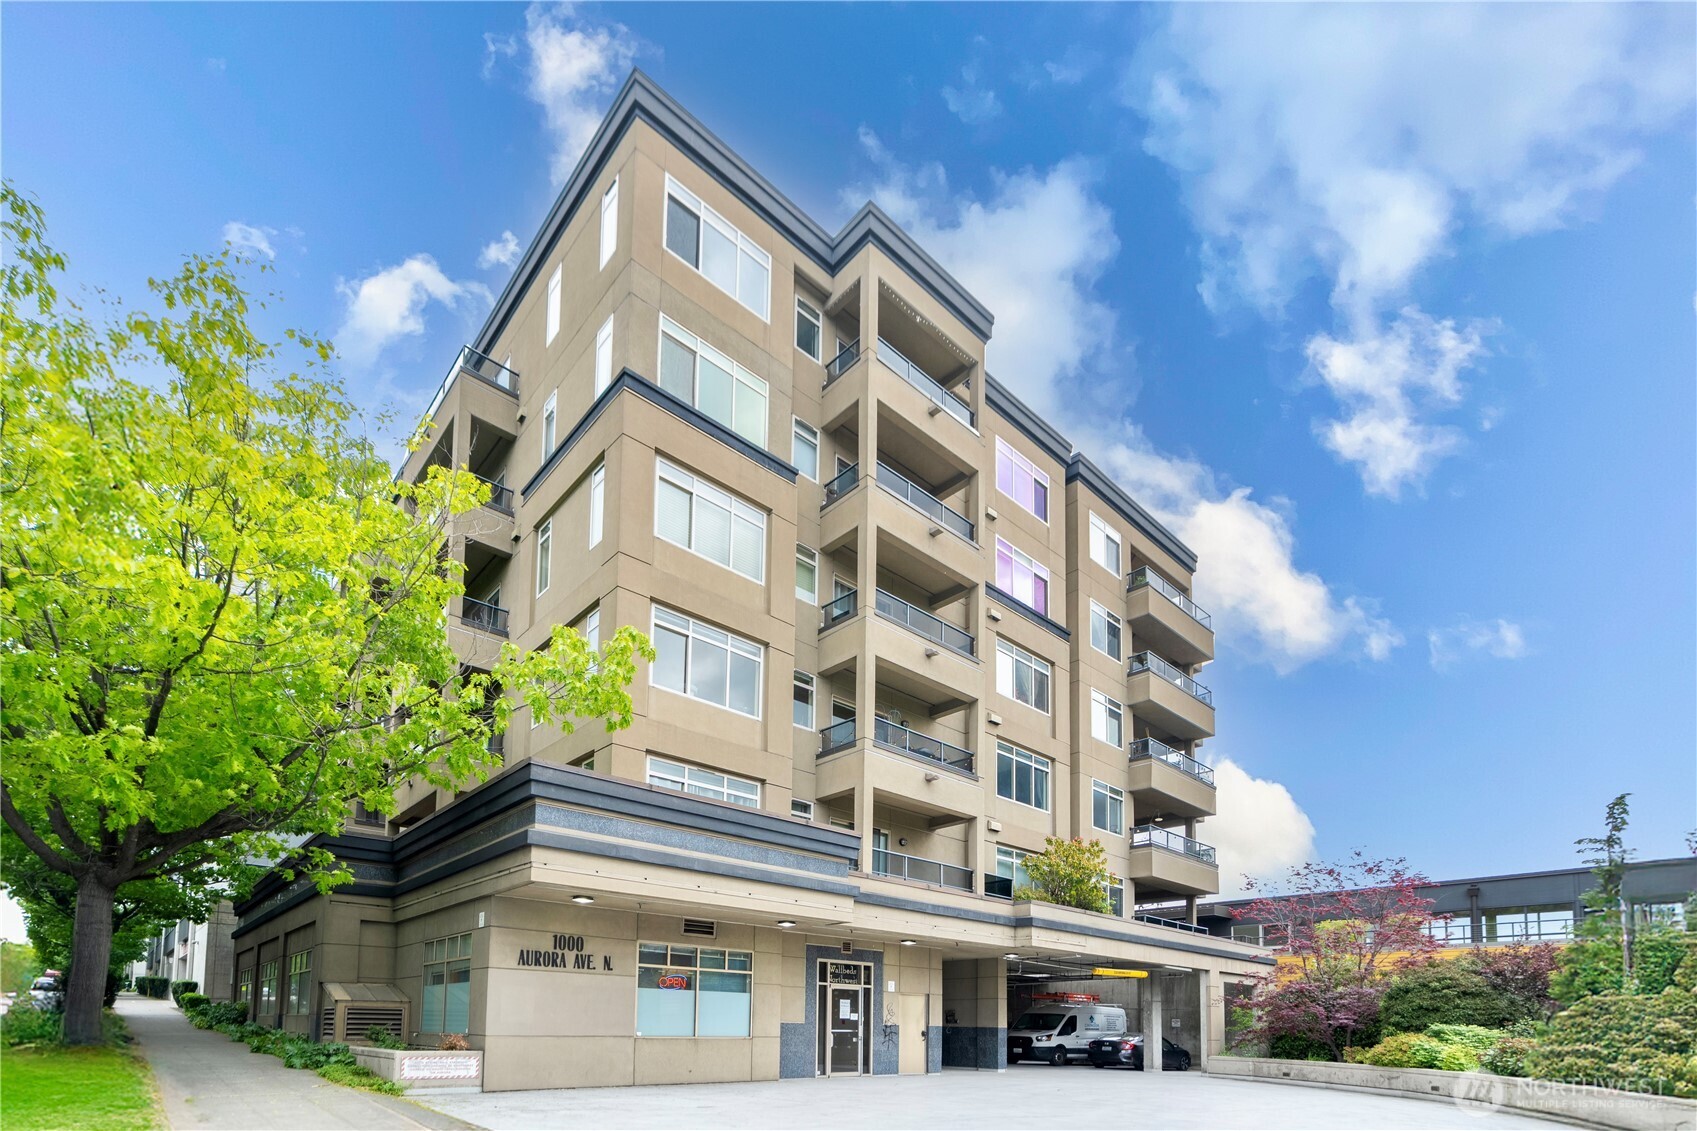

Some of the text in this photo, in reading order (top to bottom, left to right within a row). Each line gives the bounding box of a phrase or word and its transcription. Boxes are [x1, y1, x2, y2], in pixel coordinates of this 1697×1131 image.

[552, 934, 584, 952] 1000
[517, 949, 613, 971] AURORA AVE. N.
[829, 964, 857, 975] Wallbeds
[658, 976, 687, 989] OPEN
